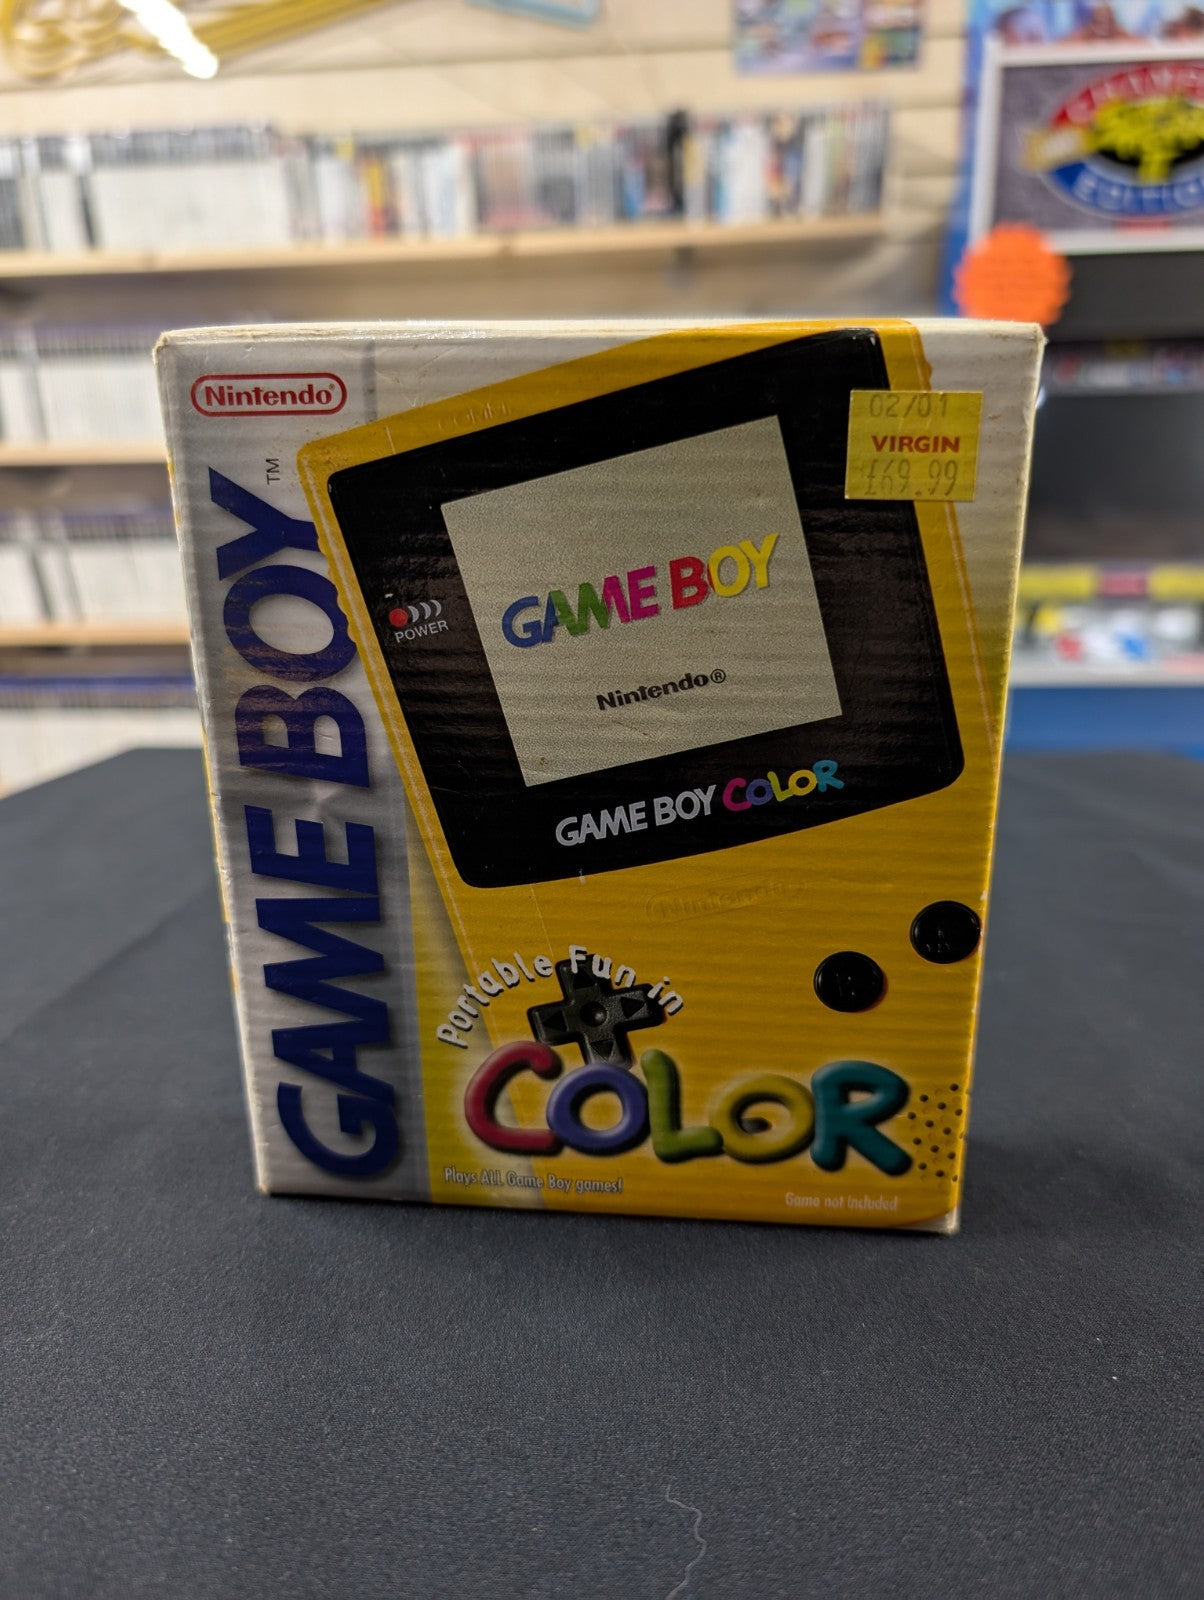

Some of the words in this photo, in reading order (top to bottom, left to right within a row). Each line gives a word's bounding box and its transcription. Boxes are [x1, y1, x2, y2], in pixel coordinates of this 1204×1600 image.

[869, 393, 948, 418] 02/01
[871, 434, 961, 454] VIRGIN
[864, 458, 959, 497] £69.99
[501, 565, 660, 649] GAME
[668, 532, 779, 611] BOY
[208, 466, 371, 790] BOY
[394, 619, 449, 644] POWER
[554, 800, 648, 847] GAME
[653, 784, 717, 827] BOY
[721, 759, 845, 812] COLOR
[245, 804, 400, 1179] GAME
[435, 950, 553, 1050] Portable
[568, 944, 637, 989] Fun
[646, 975, 684, 1017] in
[464, 1039, 914, 1177] COLOR
[444, 1167, 477, 1186] Plays
[481, 1169, 502, 1186] ALL
[506, 1171, 544, 1188] Game
[548, 1174, 572, 1193] Boy
[575, 1178, 623, 1194] games!
[785, 1191, 820, 1208] Game
[824, 1195, 844, 1209] not
